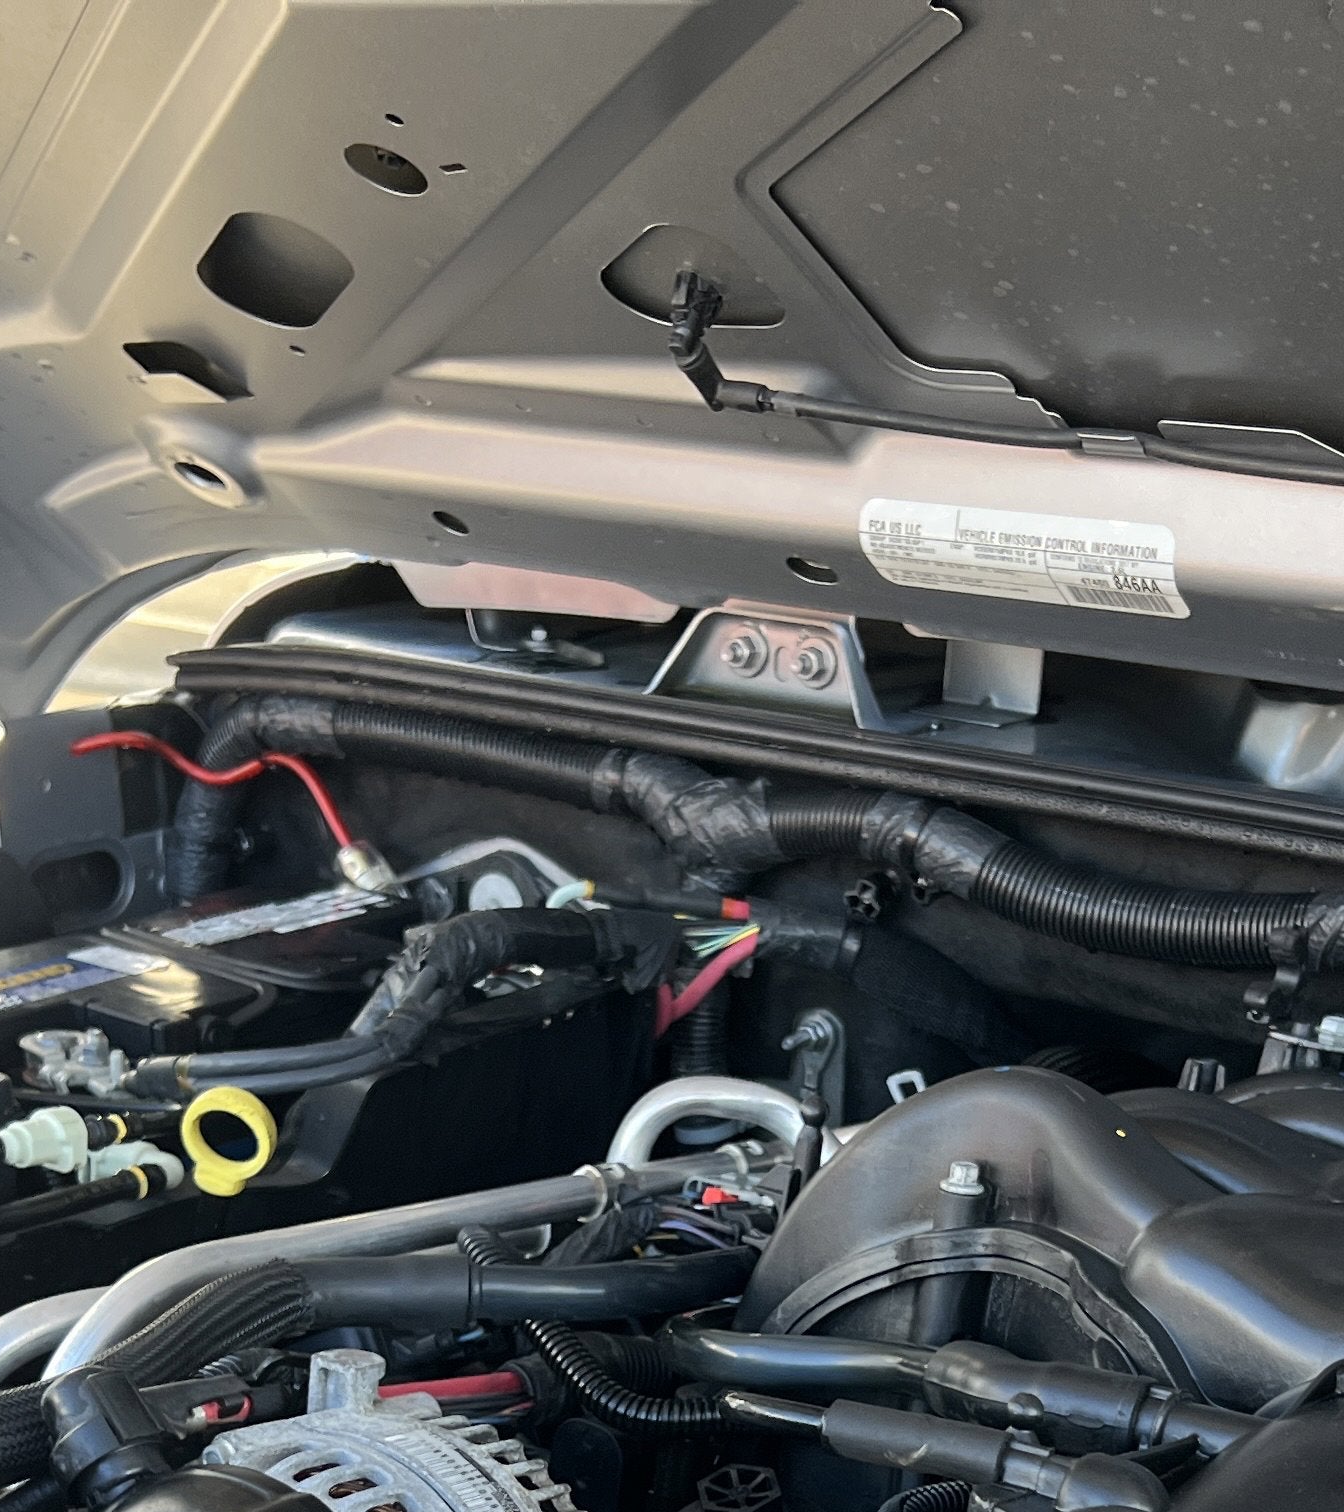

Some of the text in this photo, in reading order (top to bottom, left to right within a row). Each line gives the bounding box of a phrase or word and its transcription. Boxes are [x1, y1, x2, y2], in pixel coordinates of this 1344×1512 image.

[958, 528, 996, 543] VEHICLE
[998, 531, 1043, 547] EMISSION
[1044, 537, 1087, 553] CONTROL
[1090, 541, 1158, 560] INFORMATION
[1112, 574, 1164, 595] 846AA
